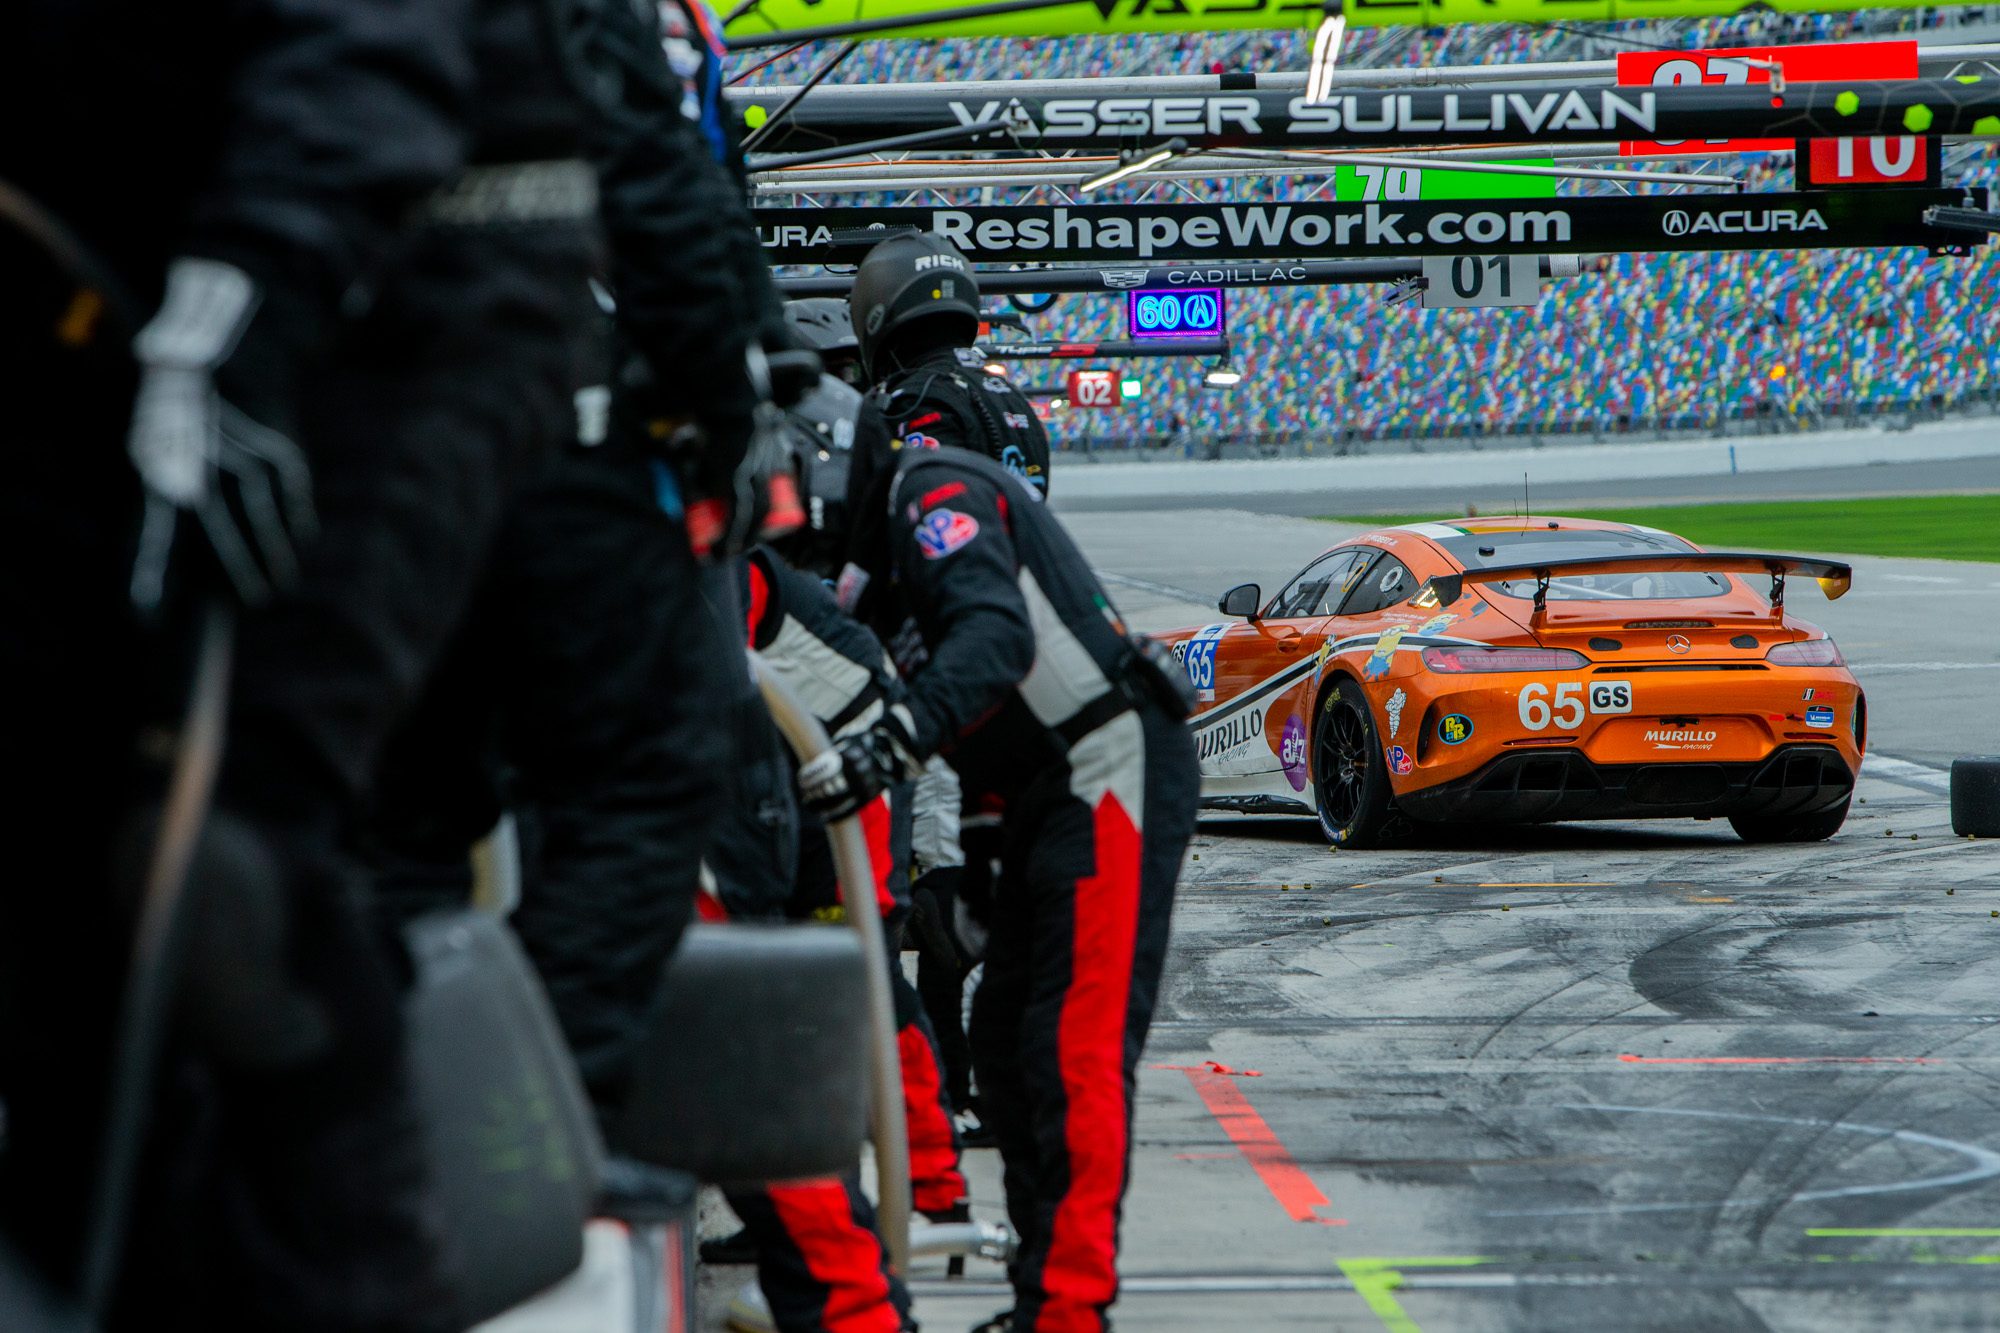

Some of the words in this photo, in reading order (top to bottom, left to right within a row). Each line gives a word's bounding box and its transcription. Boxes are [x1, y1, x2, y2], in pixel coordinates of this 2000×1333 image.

[949, 98, 1262, 141] VASSER
[1287, 90, 1656, 134] SULLIVAN
[932, 204, 1571, 257] ReshapeWork.com
[1690, 209, 1828, 233] ACURA
[915, 254, 965, 271] RICK
[1167, 267, 1306, 284] CADILLAC
[1451, 256, 1512, 298] 01
[1136, 298, 1181, 329] 60
[1077, 378, 1113, 405] 02
[1187, 642, 1216, 688] 65
[1518, 682, 1585, 731] 65
[1593, 686, 1629, 708] GS
[1644, 730, 1717, 742] MURILLO
